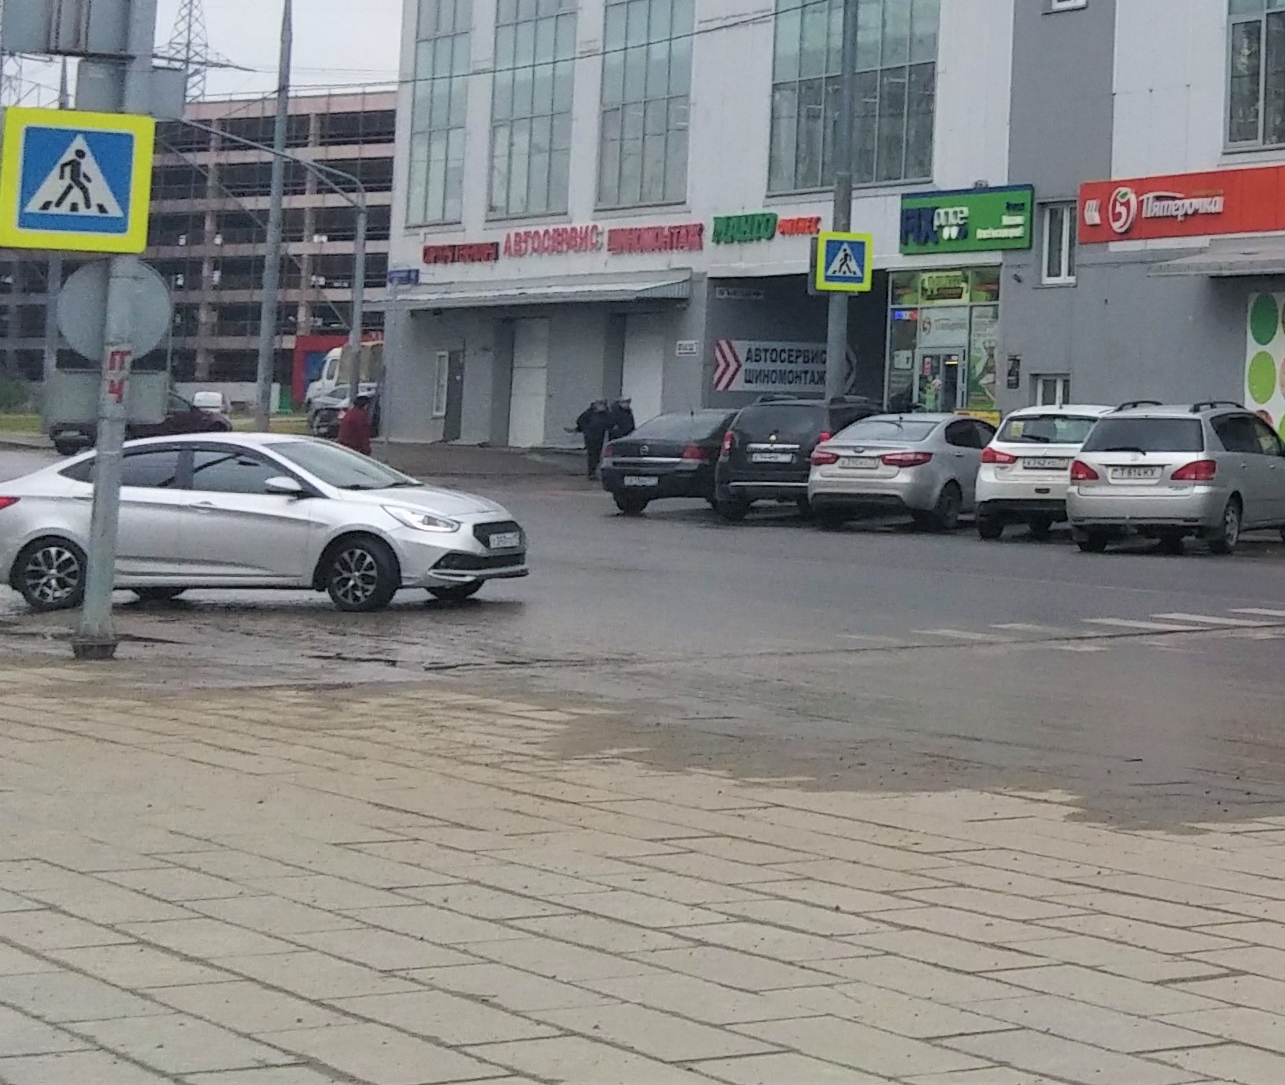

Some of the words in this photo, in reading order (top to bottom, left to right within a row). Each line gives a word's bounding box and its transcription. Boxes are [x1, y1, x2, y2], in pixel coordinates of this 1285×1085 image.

[503, 225, 602, 256] АВТОСЕРВИС
[745, 347, 827, 364] АВТОСЕРВИС
[744, 369, 826, 385] ШИНОМОНТАЖ
